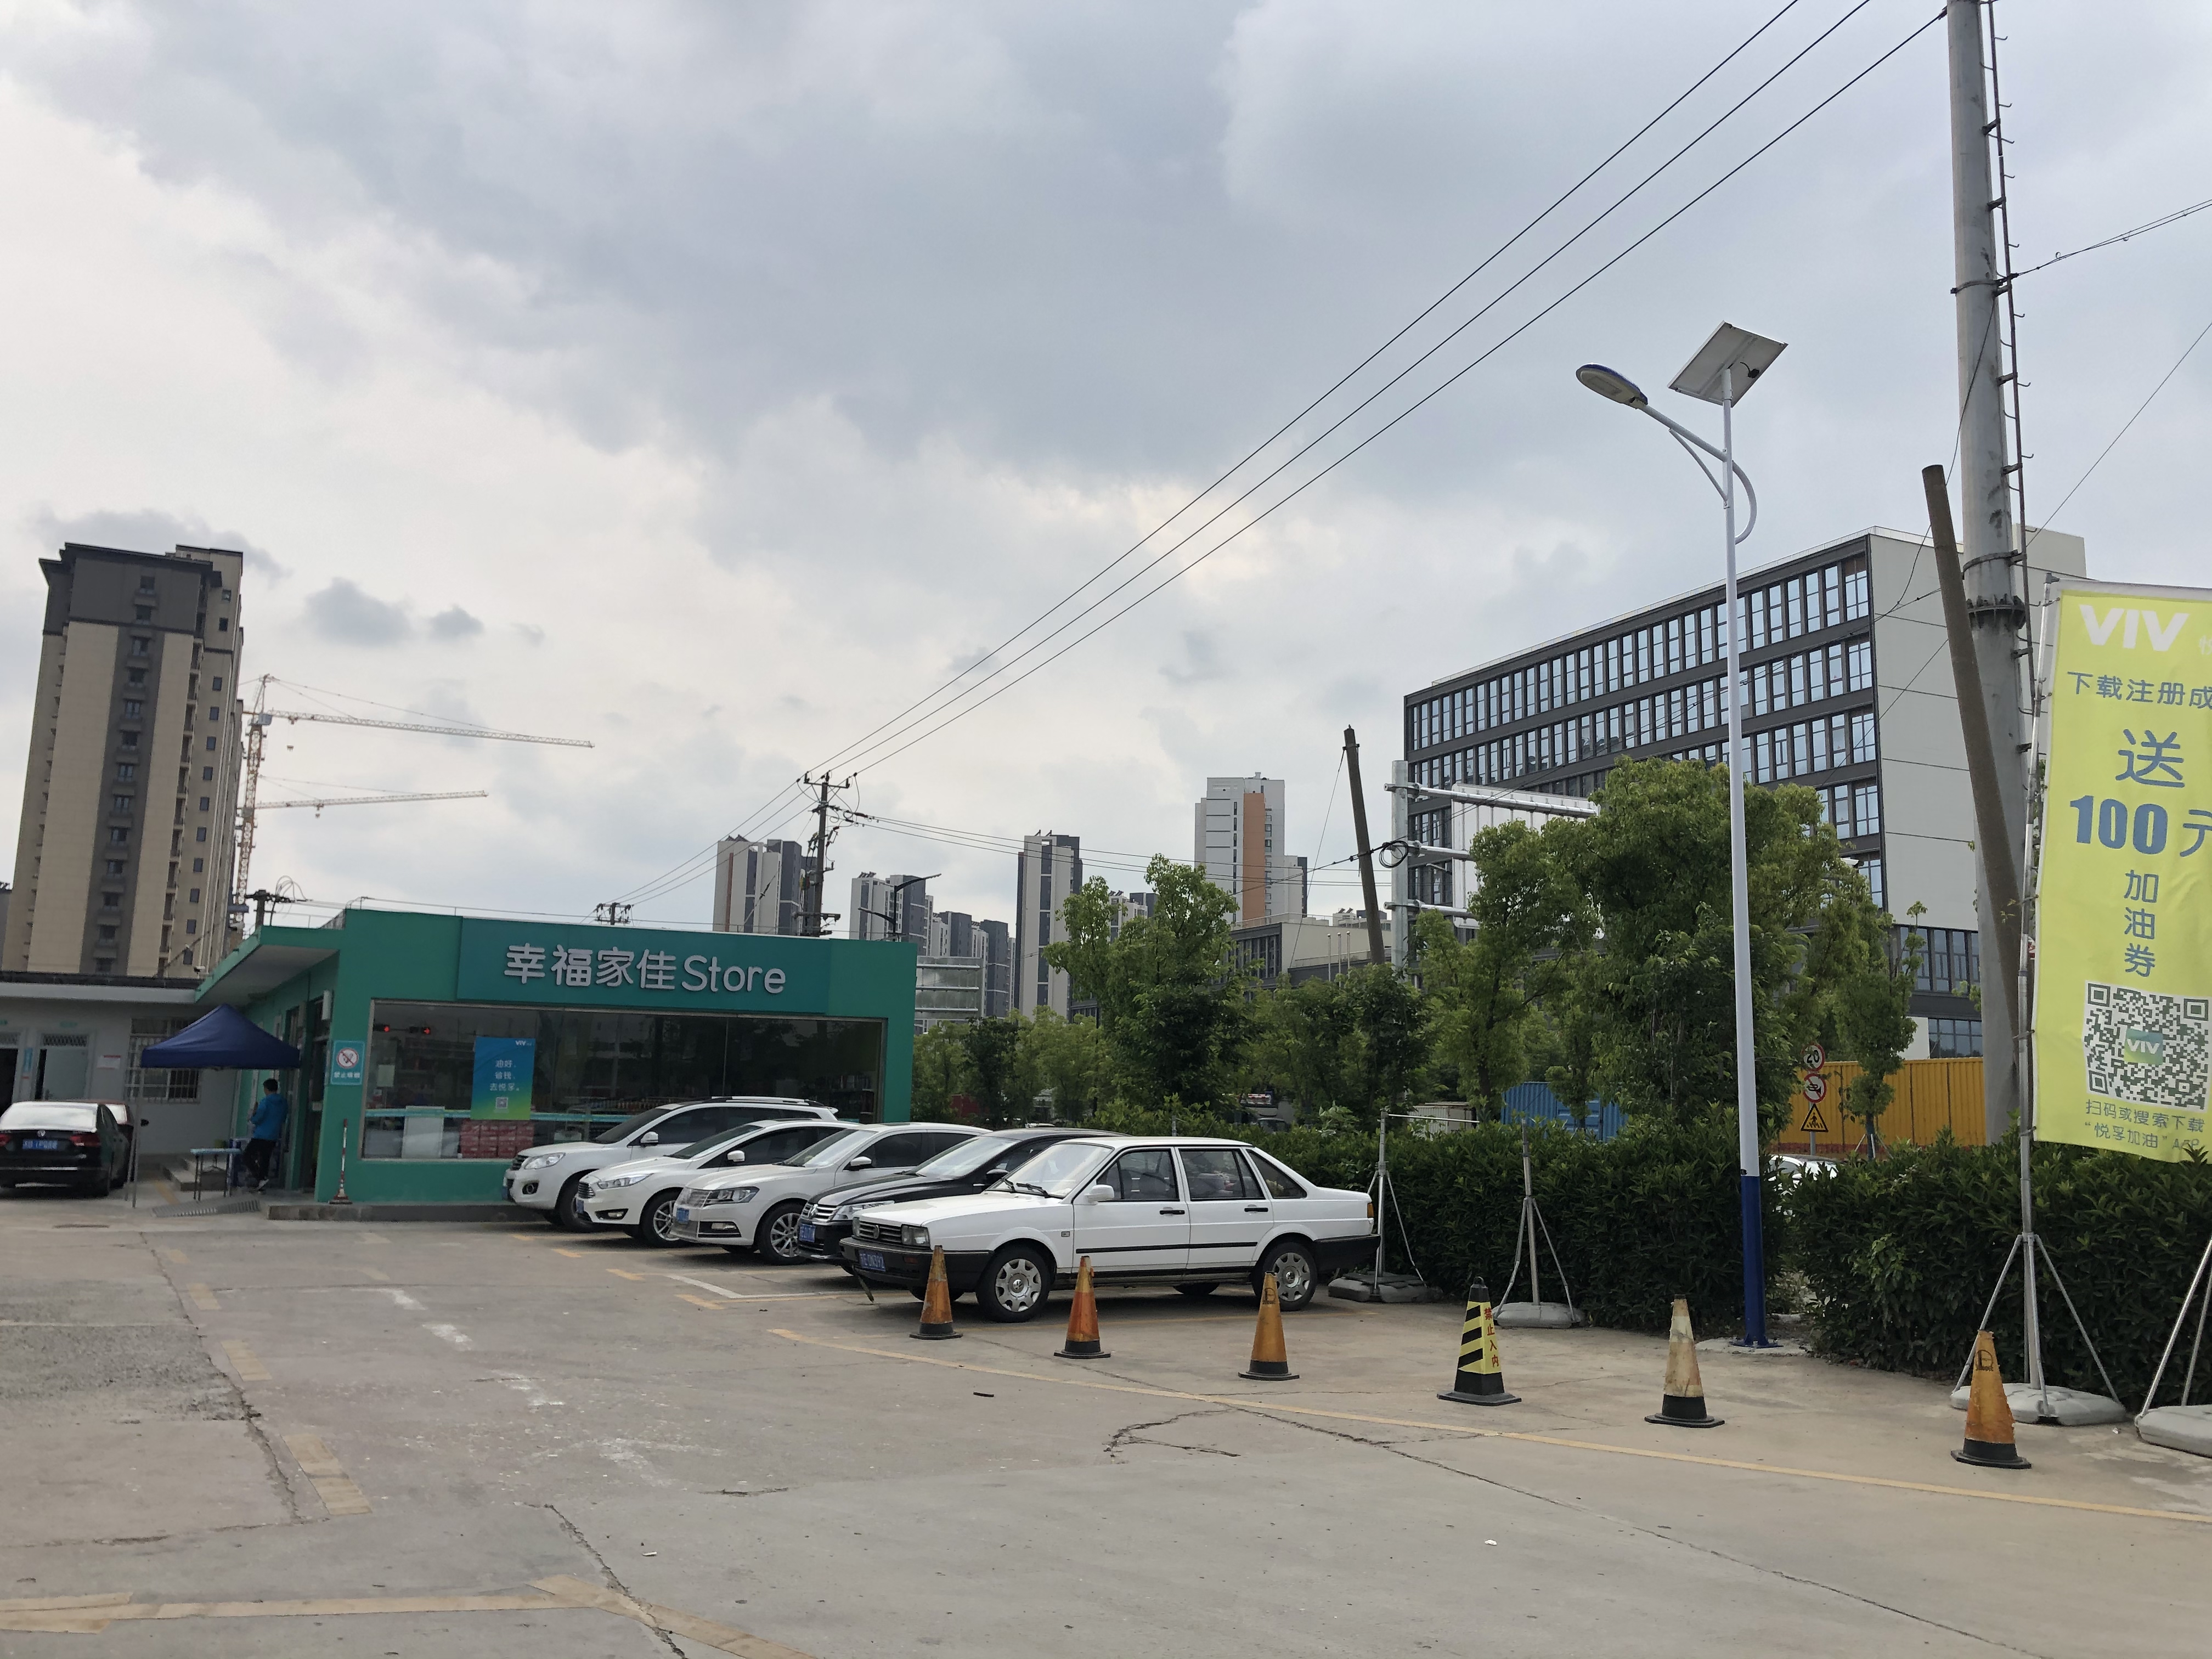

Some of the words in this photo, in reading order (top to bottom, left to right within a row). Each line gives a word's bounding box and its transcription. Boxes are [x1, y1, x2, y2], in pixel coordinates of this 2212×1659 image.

[2079, 604, 2190, 652] VIV
[2067, 671, 2212, 710] 下载注册成
[2115, 729, 2185, 788] 送
[2124, 870, 2159, 978] 加油券
[1807, 1049, 1820, 1063] 20
[2127, 1039, 2160, 1054] VIV
[2085, 1099, 2205, 1133] 扫码或搜索下载
[1484, 1307, 1499, 1368] 禁止入内
